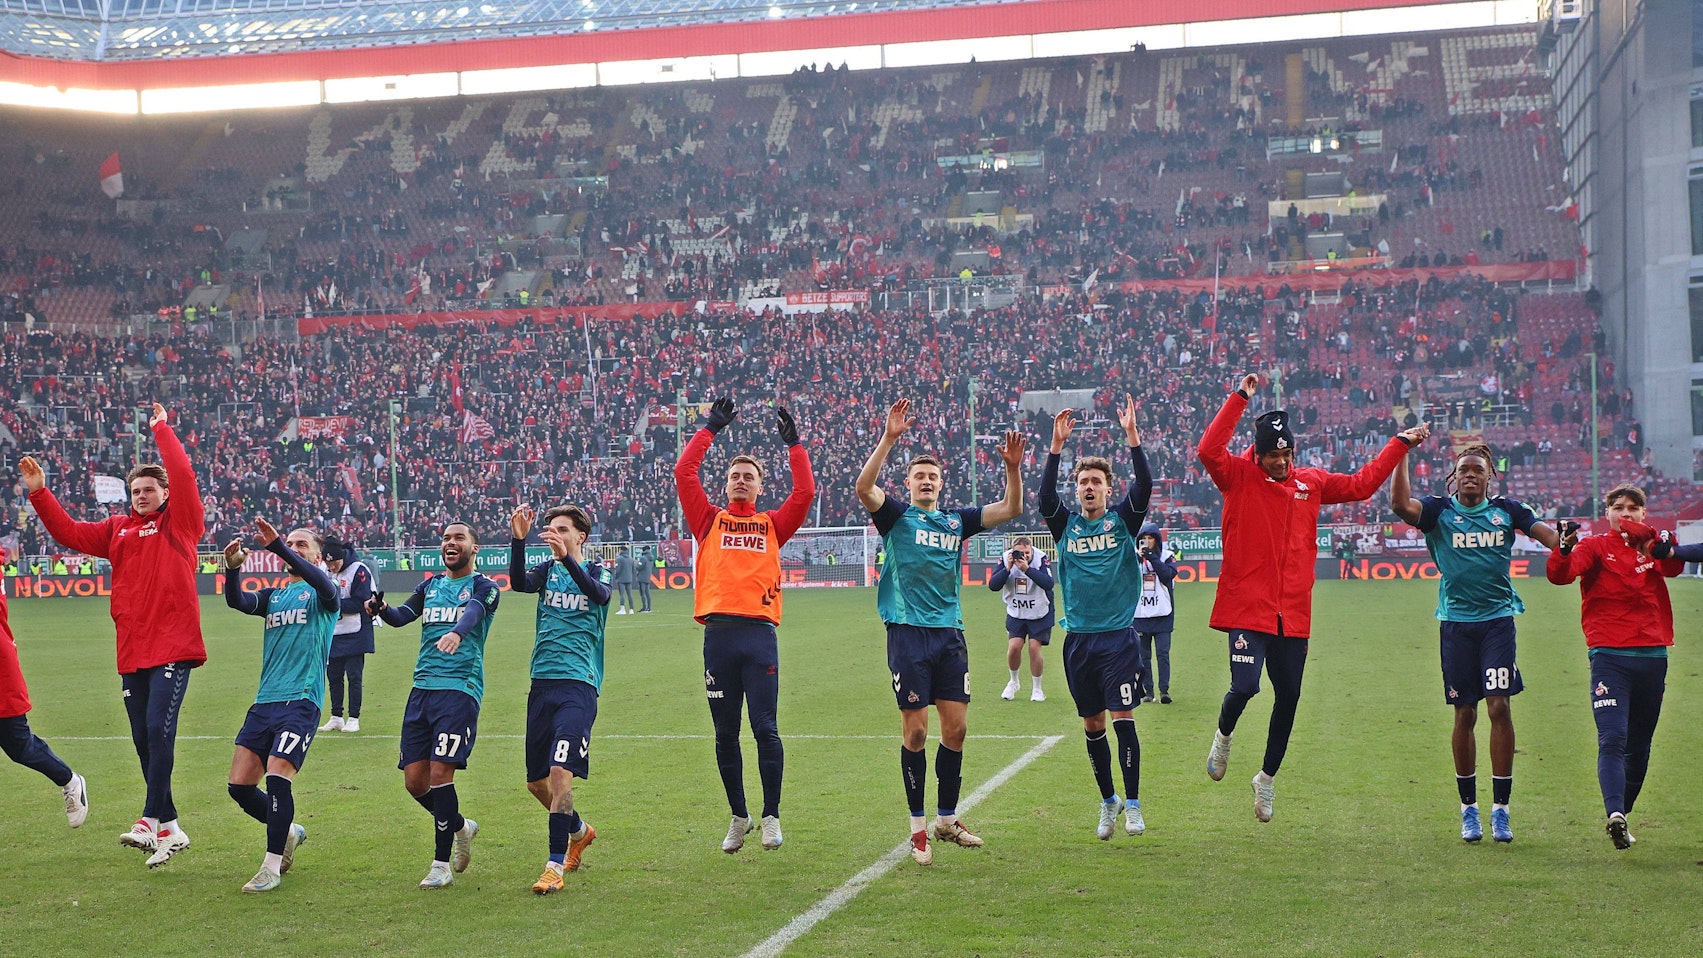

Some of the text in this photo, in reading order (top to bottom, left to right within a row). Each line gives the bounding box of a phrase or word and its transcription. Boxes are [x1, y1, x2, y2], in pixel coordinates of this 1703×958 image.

[802, 291, 868, 303] BETZE SUPPORTERS
[138, 526, 159, 538] REWE
[719, 518, 769, 536] hummel
[723, 535, 765, 550] REWE
[915, 529, 962, 551] REWE
[1067, 534, 1118, 554] REWE
[1452, 530, 1505, 548] REWE
[420, 554, 435, 567] für
[487, 552, 508, 565] und
[544, 589, 590, 611] REWE
[1012, 598, 1036, 609] SMF
[266, 608, 307, 630] REWE
[422, 607, 466, 623] REWE
[1232, 654, 1255, 664] REWE
[1485, 667, 1510, 691] 38
[1119, 682, 1133, 706] 9
[1594, 699, 1618, 709] REWE
[277, 730, 302, 756] 17
[435, 732, 462, 758] 37
[553, 739, 570, 764] 8
